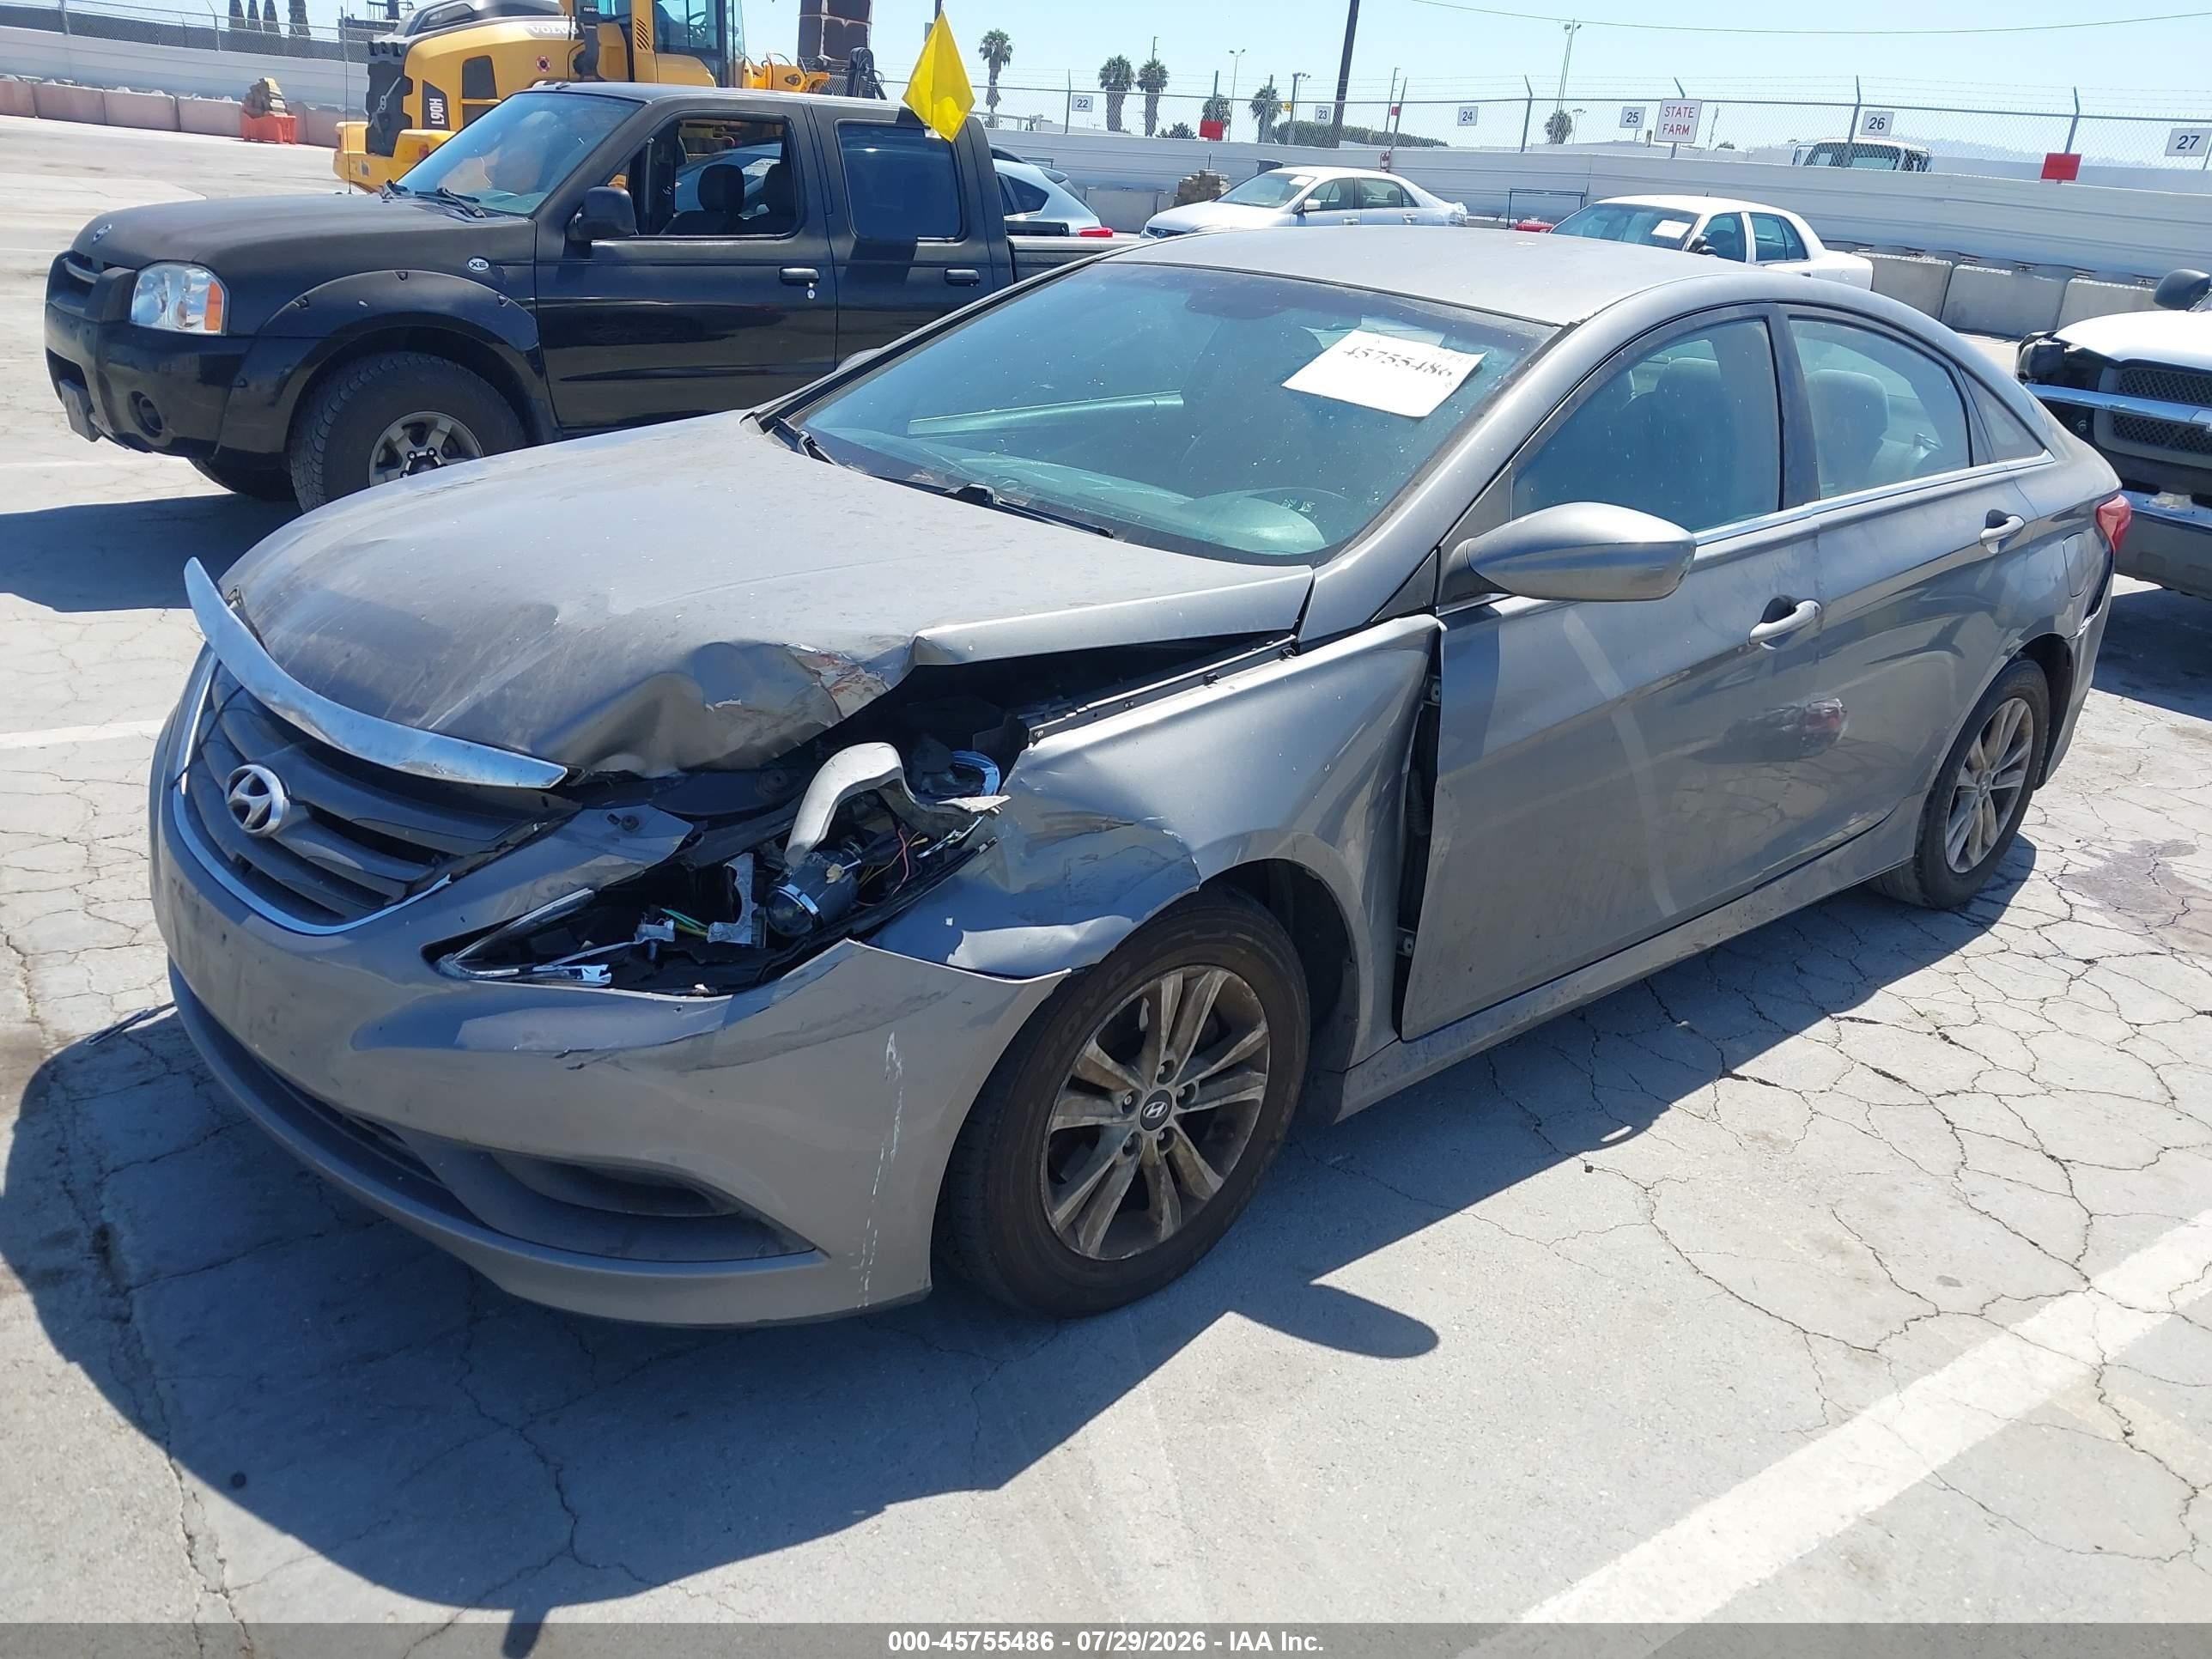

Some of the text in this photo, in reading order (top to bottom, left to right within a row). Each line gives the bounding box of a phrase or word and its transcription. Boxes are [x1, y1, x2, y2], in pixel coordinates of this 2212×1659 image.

[529, 26, 580, 34] VOLVO
[1077, 99, 1089, 108] 22
[428, 97, 446, 125] L90H
[1318, 110, 1328, 120] 23
[1462, 111, 1473, 122] 24
[1664, 106, 1696, 118] STATE
[1626, 112, 1639, 124] 25
[1868, 117, 1886, 131] 26
[1662, 123, 1691, 136] FARM
[2176, 135, 2201, 150] 27
